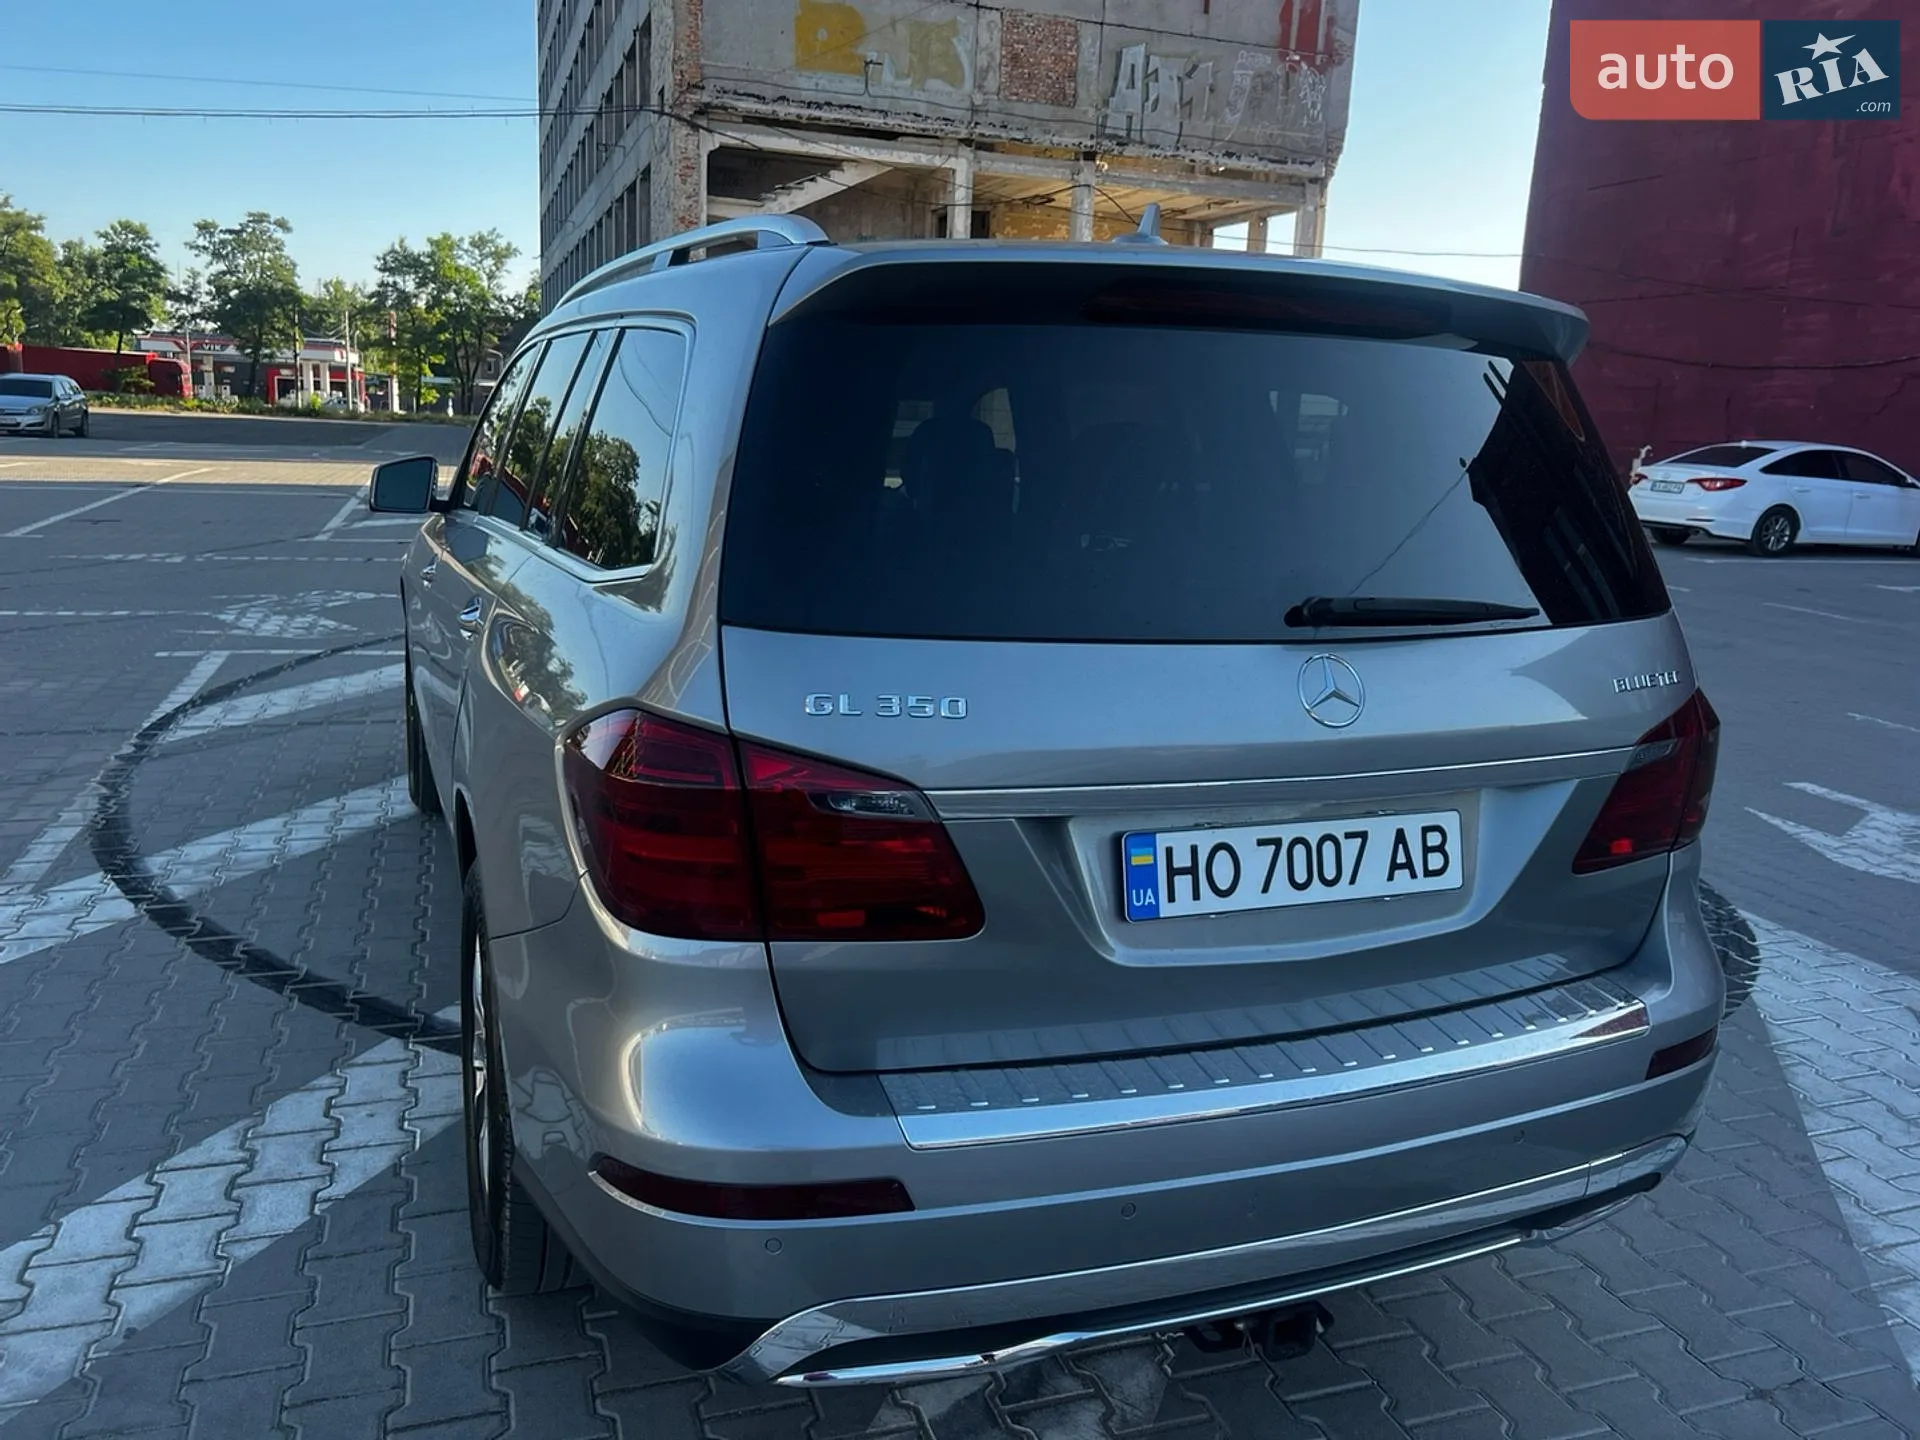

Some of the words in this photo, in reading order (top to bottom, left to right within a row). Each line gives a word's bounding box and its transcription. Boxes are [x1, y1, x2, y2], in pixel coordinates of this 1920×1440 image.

[805, 693, 863, 716] GL
[876, 694, 967, 719] 350
[1164, 840, 1242, 904] HO
[1256, 830, 1369, 895] 7007
[1386, 824, 1450, 883] AB
[1132, 888, 1156, 907] UA
